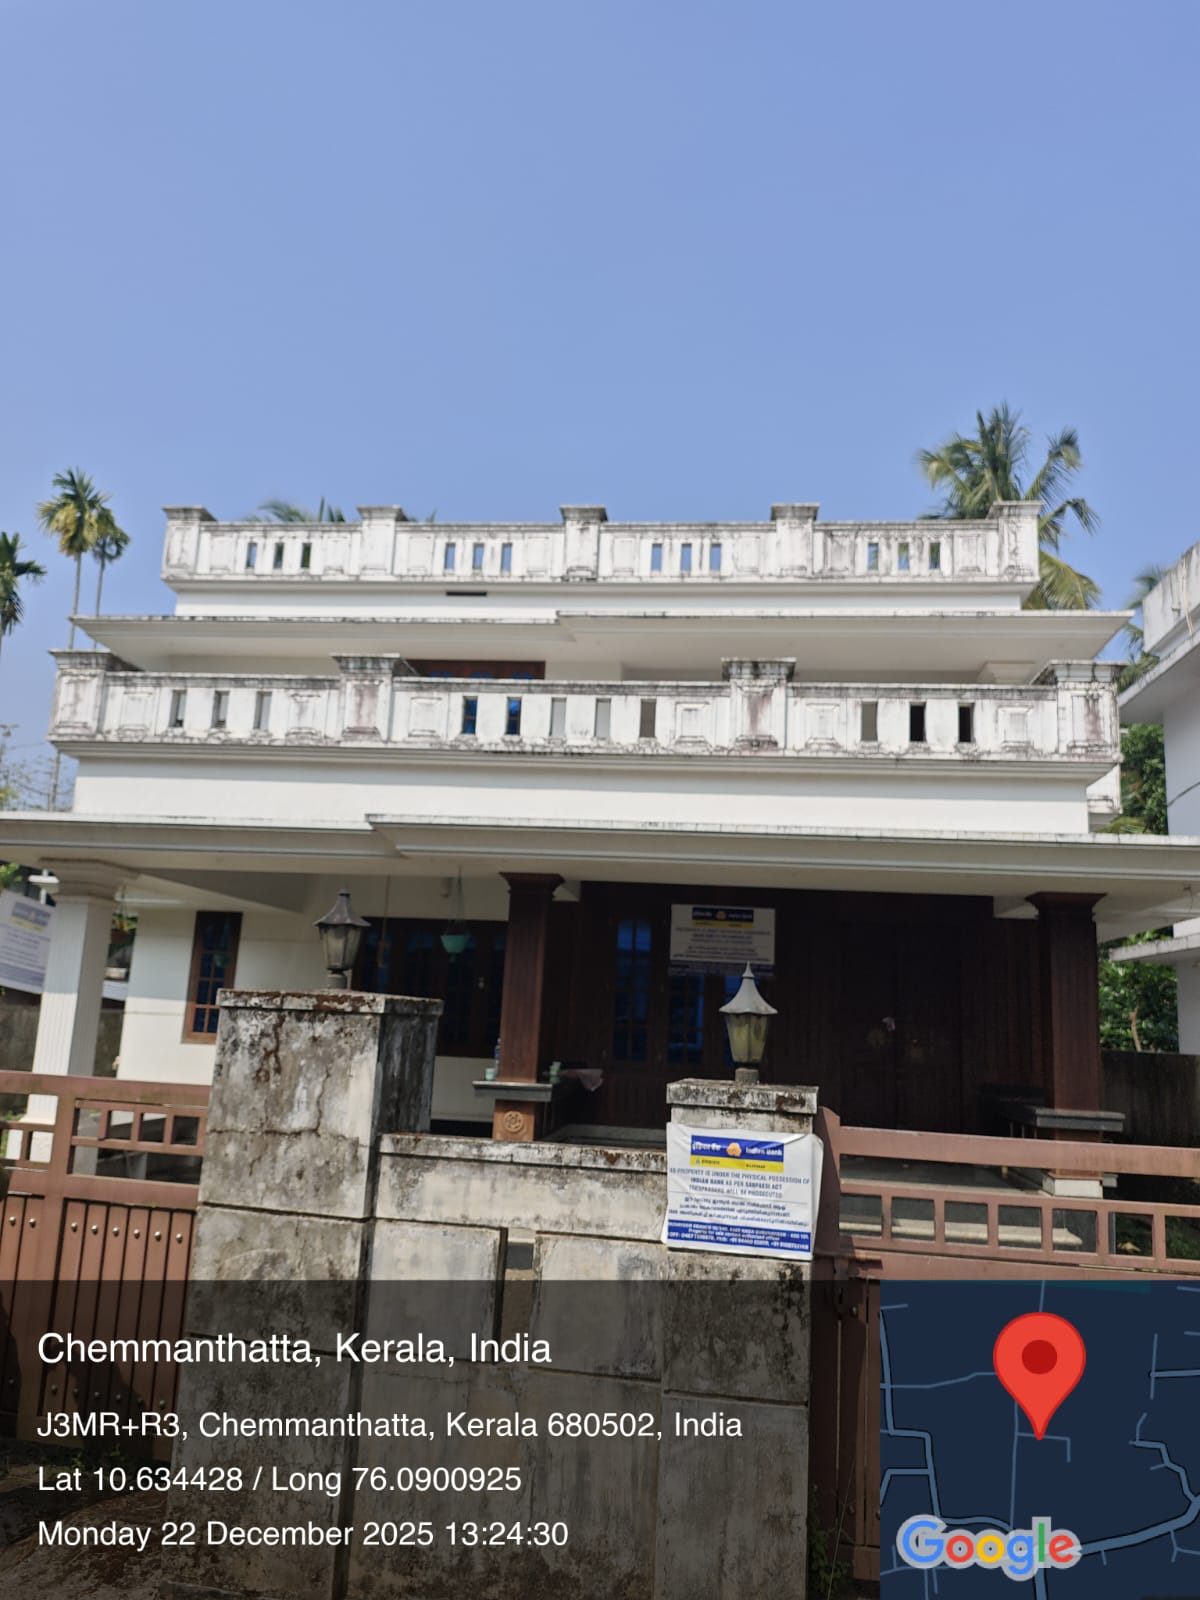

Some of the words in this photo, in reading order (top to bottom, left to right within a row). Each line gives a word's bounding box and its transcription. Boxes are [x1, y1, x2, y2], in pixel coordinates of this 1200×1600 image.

[678, 1168, 704, 1176] PROPERTY
[711, 1170, 730, 1178] UNDER
[741, 1173, 767, 1181] PHYSICAL
[768, 1175, 801, 1184] POSSESSION
[690, 1177, 709, 1185] INDIAN
[709, 1178, 725, 1186] BANK
[748, 1189, 783, 1198] PROSECUTED
